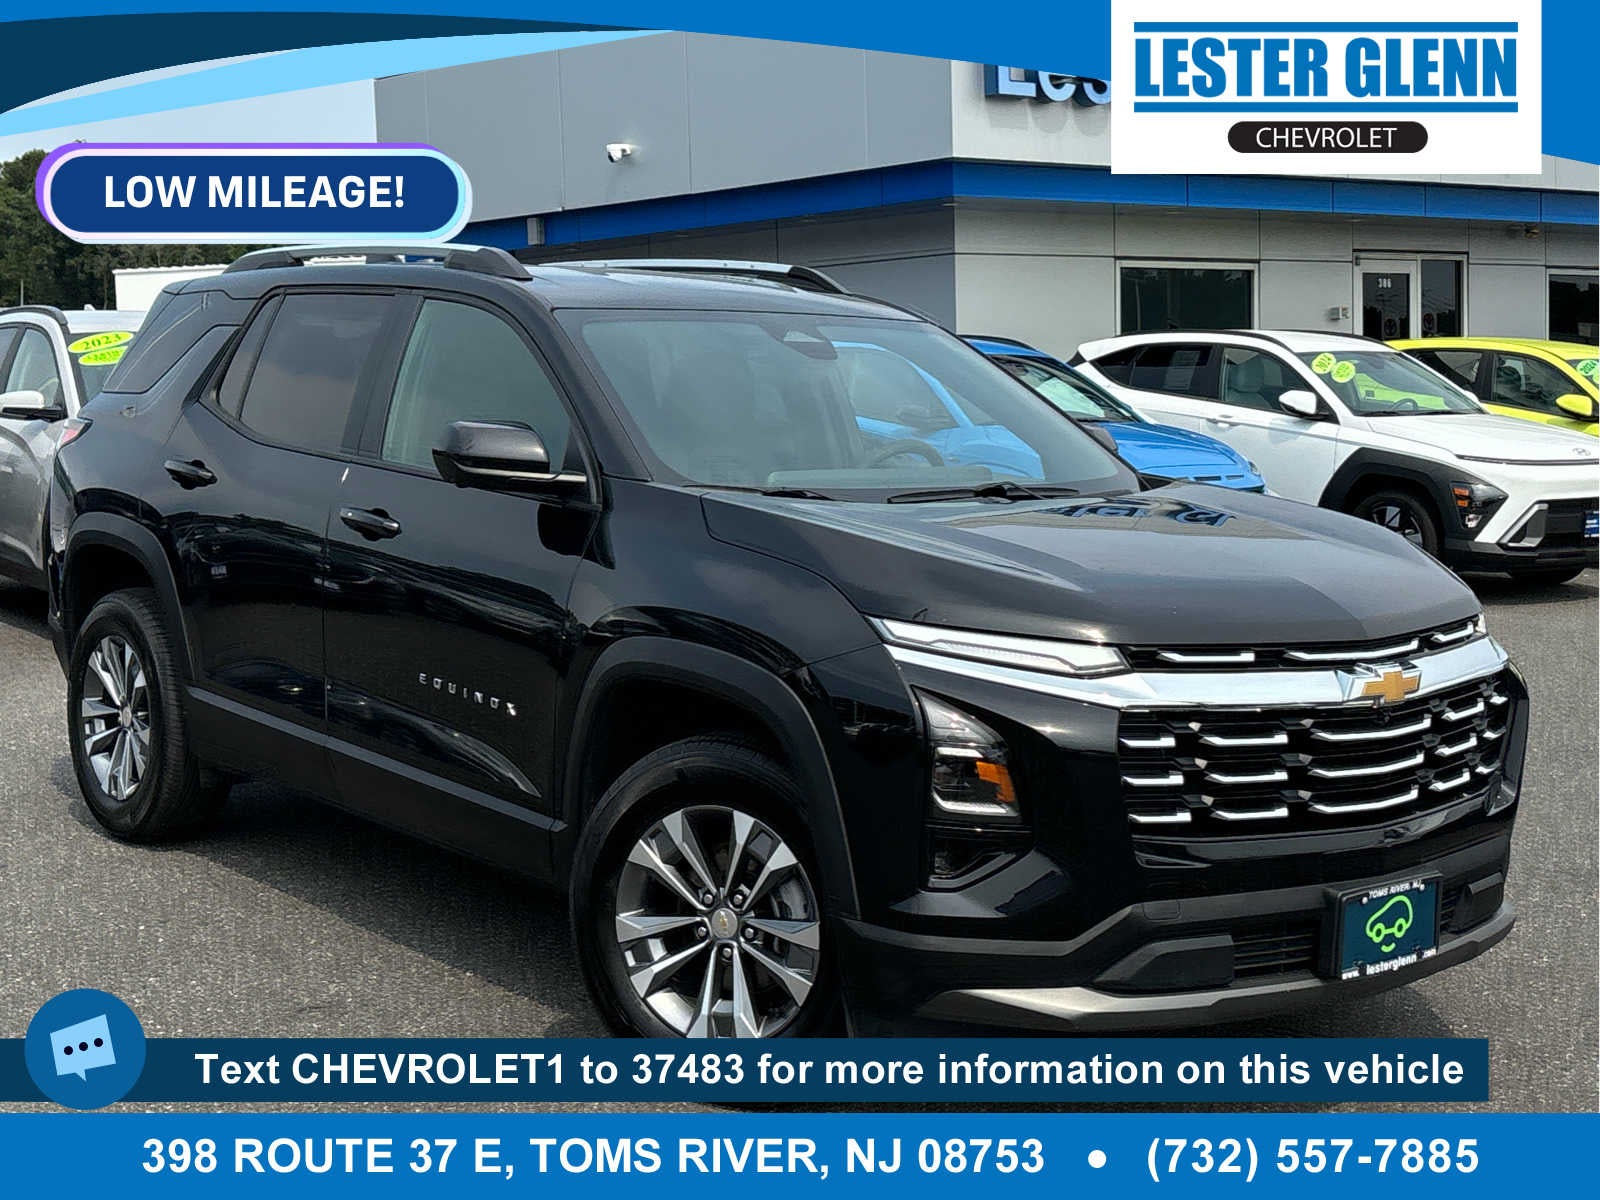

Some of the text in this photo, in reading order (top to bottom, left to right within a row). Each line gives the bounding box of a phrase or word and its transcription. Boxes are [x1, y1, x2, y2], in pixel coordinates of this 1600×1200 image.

[81, 333, 122, 350] 2023
[418, 672, 517, 717] EQUINOX
[1368, 887, 1388, 899] TOMS
[1366, 954, 1417, 975] lesterglenn
